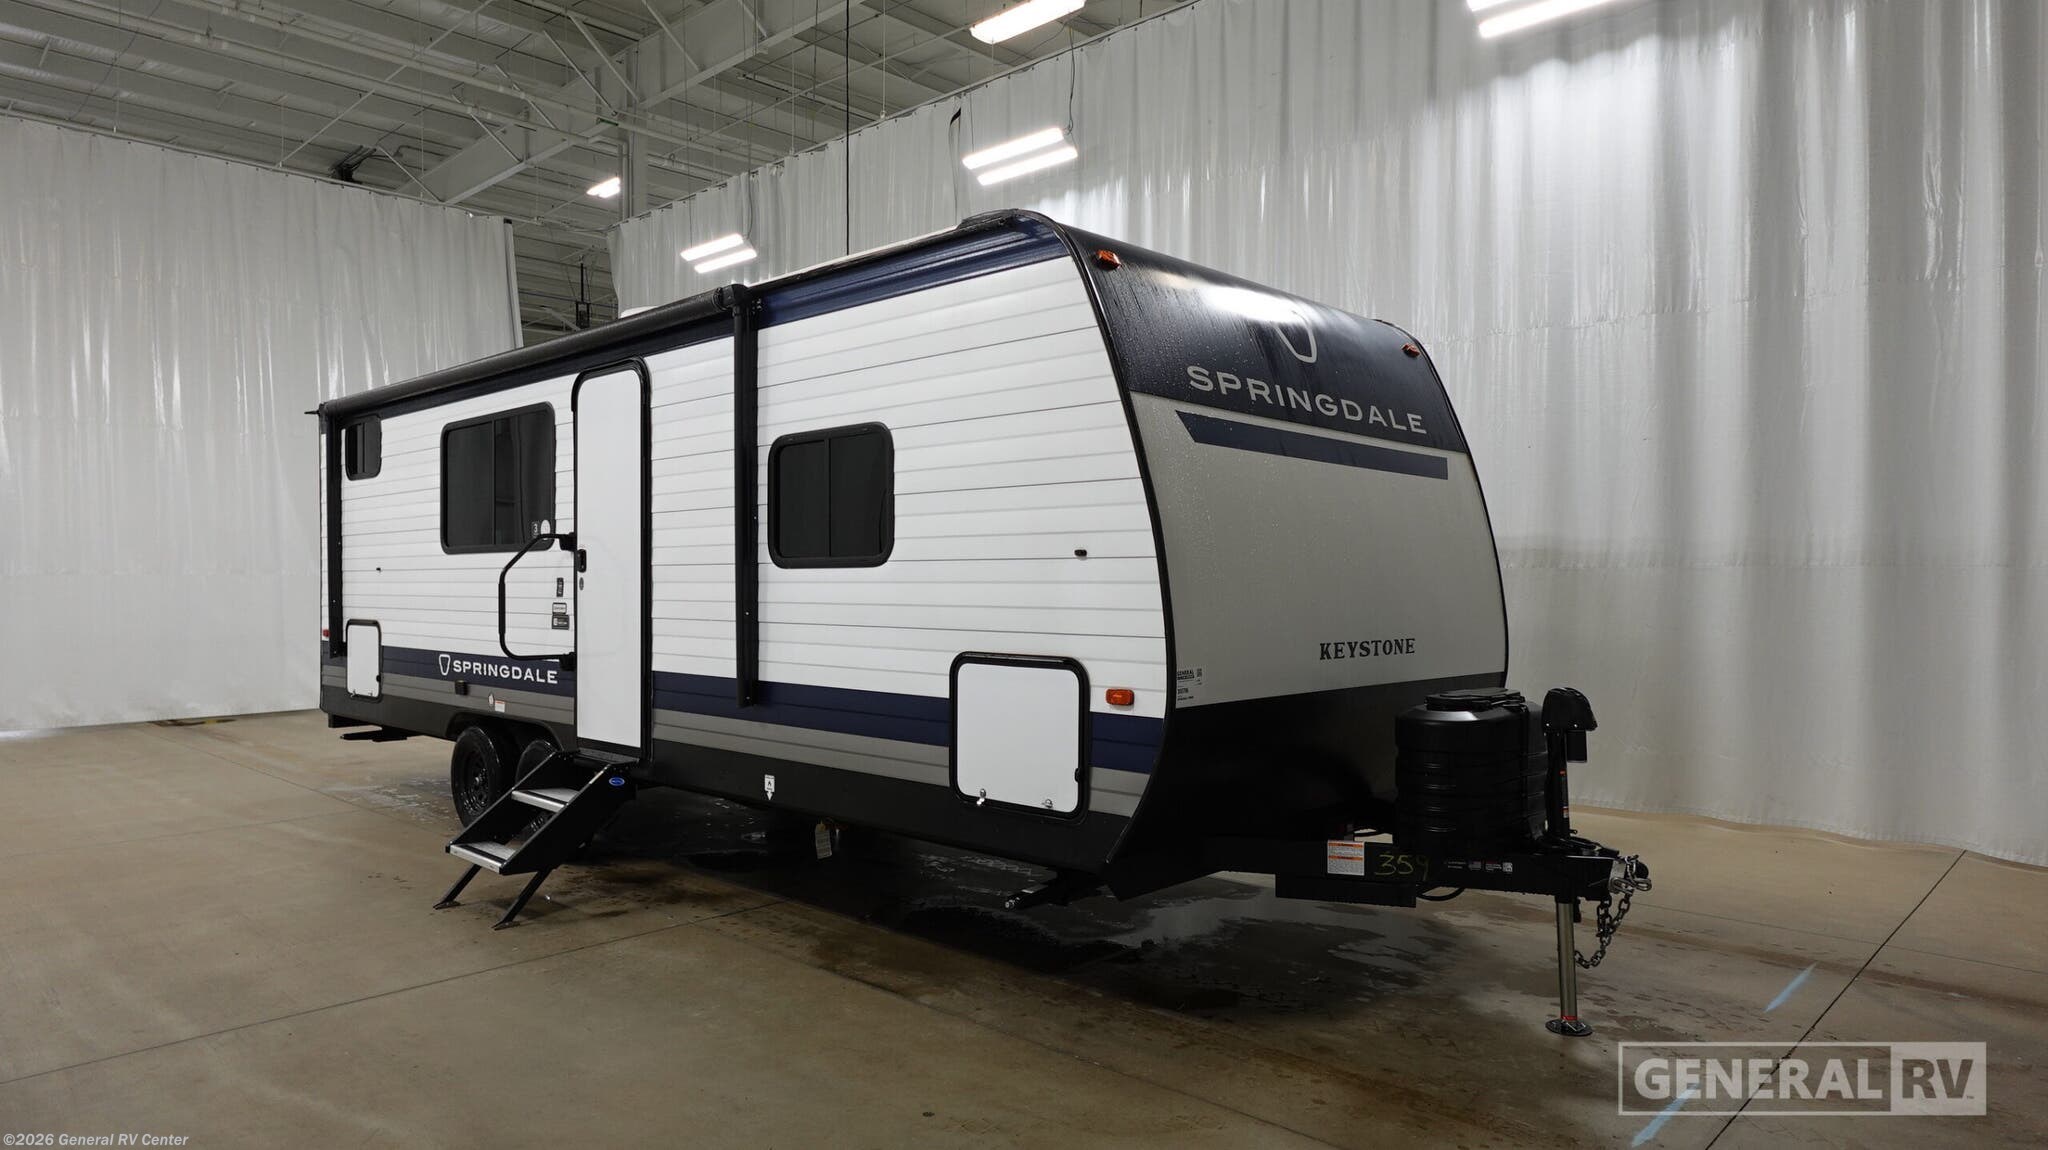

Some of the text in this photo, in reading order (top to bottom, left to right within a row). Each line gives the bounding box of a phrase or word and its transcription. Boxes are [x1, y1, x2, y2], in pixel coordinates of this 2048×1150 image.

[1186, 365, 1427, 434] SPRINGDALE
[1320, 638, 1415, 660] KEYSTONE
[453, 660, 558, 684] SPRINGDALE
